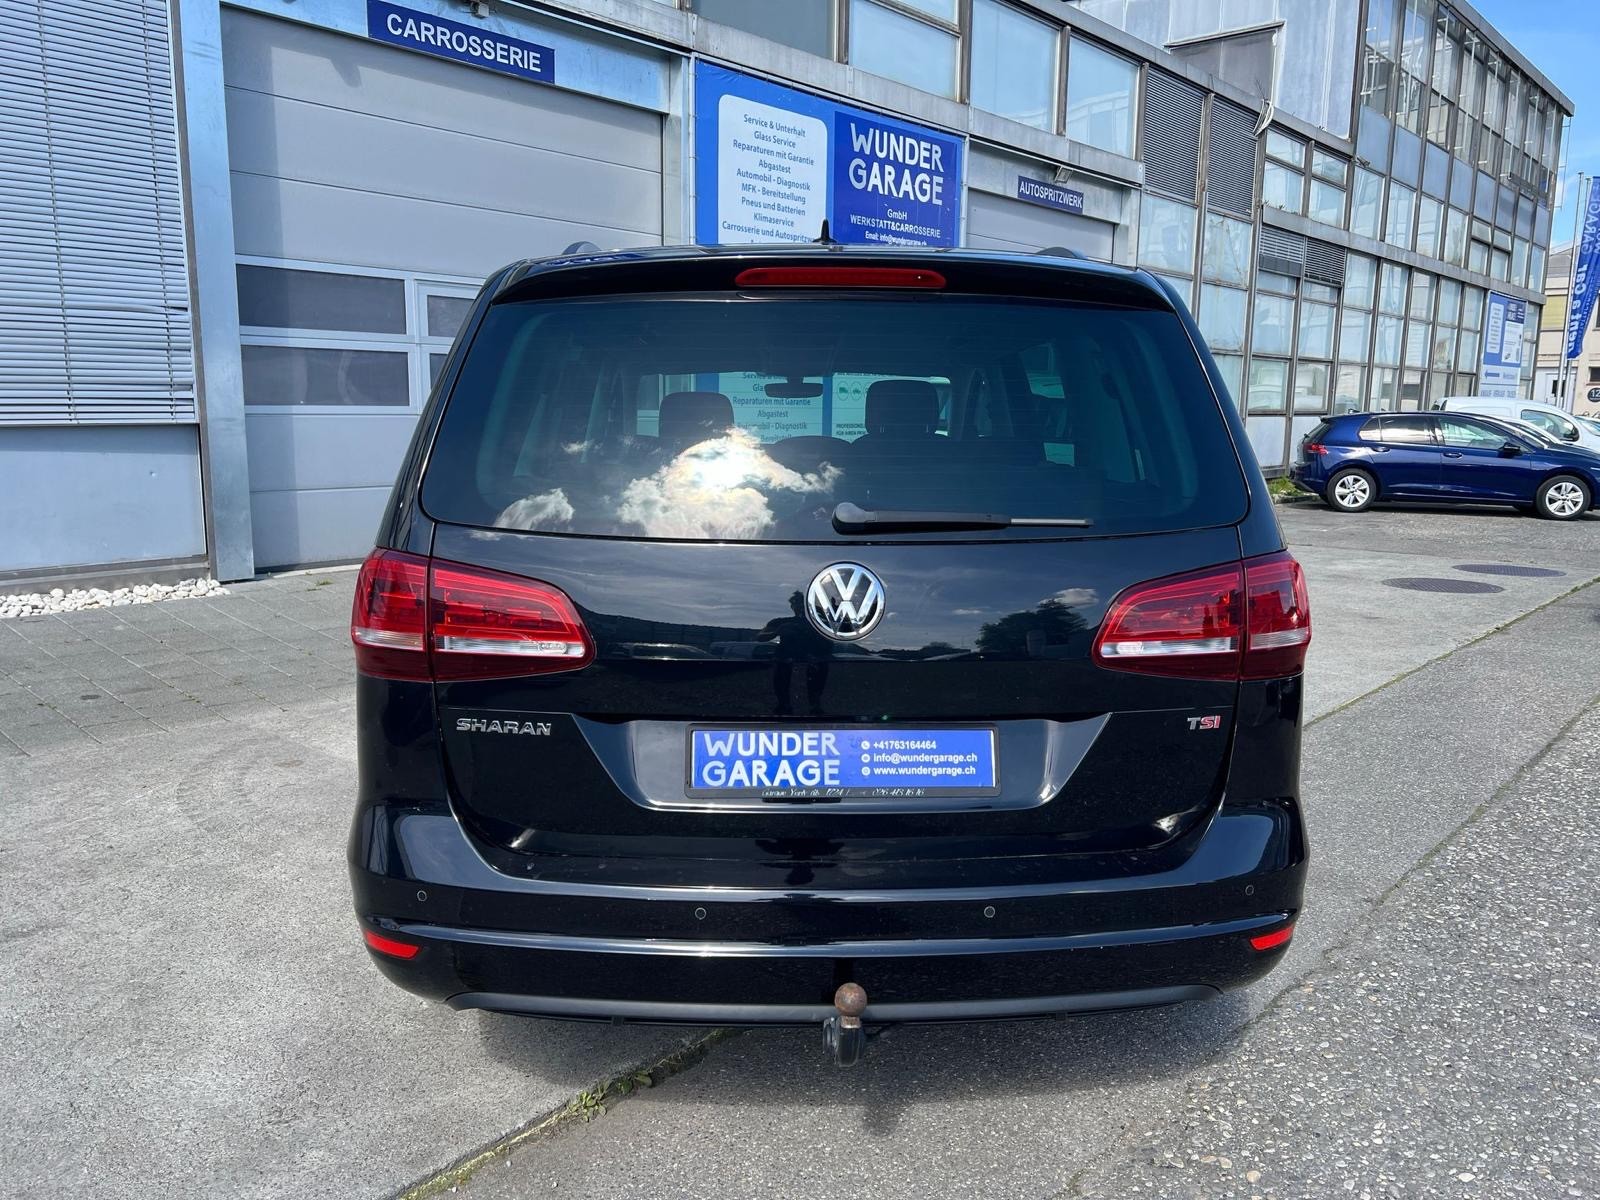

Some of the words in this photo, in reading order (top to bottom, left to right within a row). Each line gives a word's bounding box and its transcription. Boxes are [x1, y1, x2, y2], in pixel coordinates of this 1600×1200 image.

[386, 13, 541, 72] CARROSSERIE
[743, 114, 768, 128] Service
[769, 120, 775, 128] &
[775, 122, 806, 138] Unterhalt
[754, 130, 772, 142] Glass
[773, 135, 796, 149] Service
[850, 122, 944, 173] WUNDER
[733, 138, 775, 157] Reparaturen
[775, 150, 787, 161] mit
[788, 152, 815, 166] Garantie
[758, 159, 791, 174] Abgastest
[736, 168, 772, 183] Automobil
[777, 176, 811, 191] Diagnostik
[848, 157, 944, 206] GARAGE
[741, 183, 757, 193] MFK
[762, 187, 806, 205] Bereitstellung
[1019, 181, 1083, 209] AUTOSPRITZWERK
[741, 196, 762, 208] Pneus
[763, 201, 776, 211] und
[777, 203, 806, 217] Batterien
[887, 208, 908, 220] GmbH
[722, 220, 761, 235] Carrosserie
[761, 227, 774, 237] und
[753, 212, 795, 228] Klimaservice
[850, 214, 941, 239] WERKSTATT&CARROSSERIE
[732, 396, 773, 406] Reparaturen
[757, 410, 789, 420] Abgastest
[775, 422, 808, 432] Diagnostik
[456, 717, 552, 736] SHARAN
[1187, 715, 1221, 730] TSI
[703, 732, 840, 757] WUNDER
[873, 740, 937, 750] +41763164464
[873, 752, 978, 764] info@wundergarage.ch
[702, 759, 841, 787] GARAGE
[873, 765, 976, 777] www.wundergarage.ch
